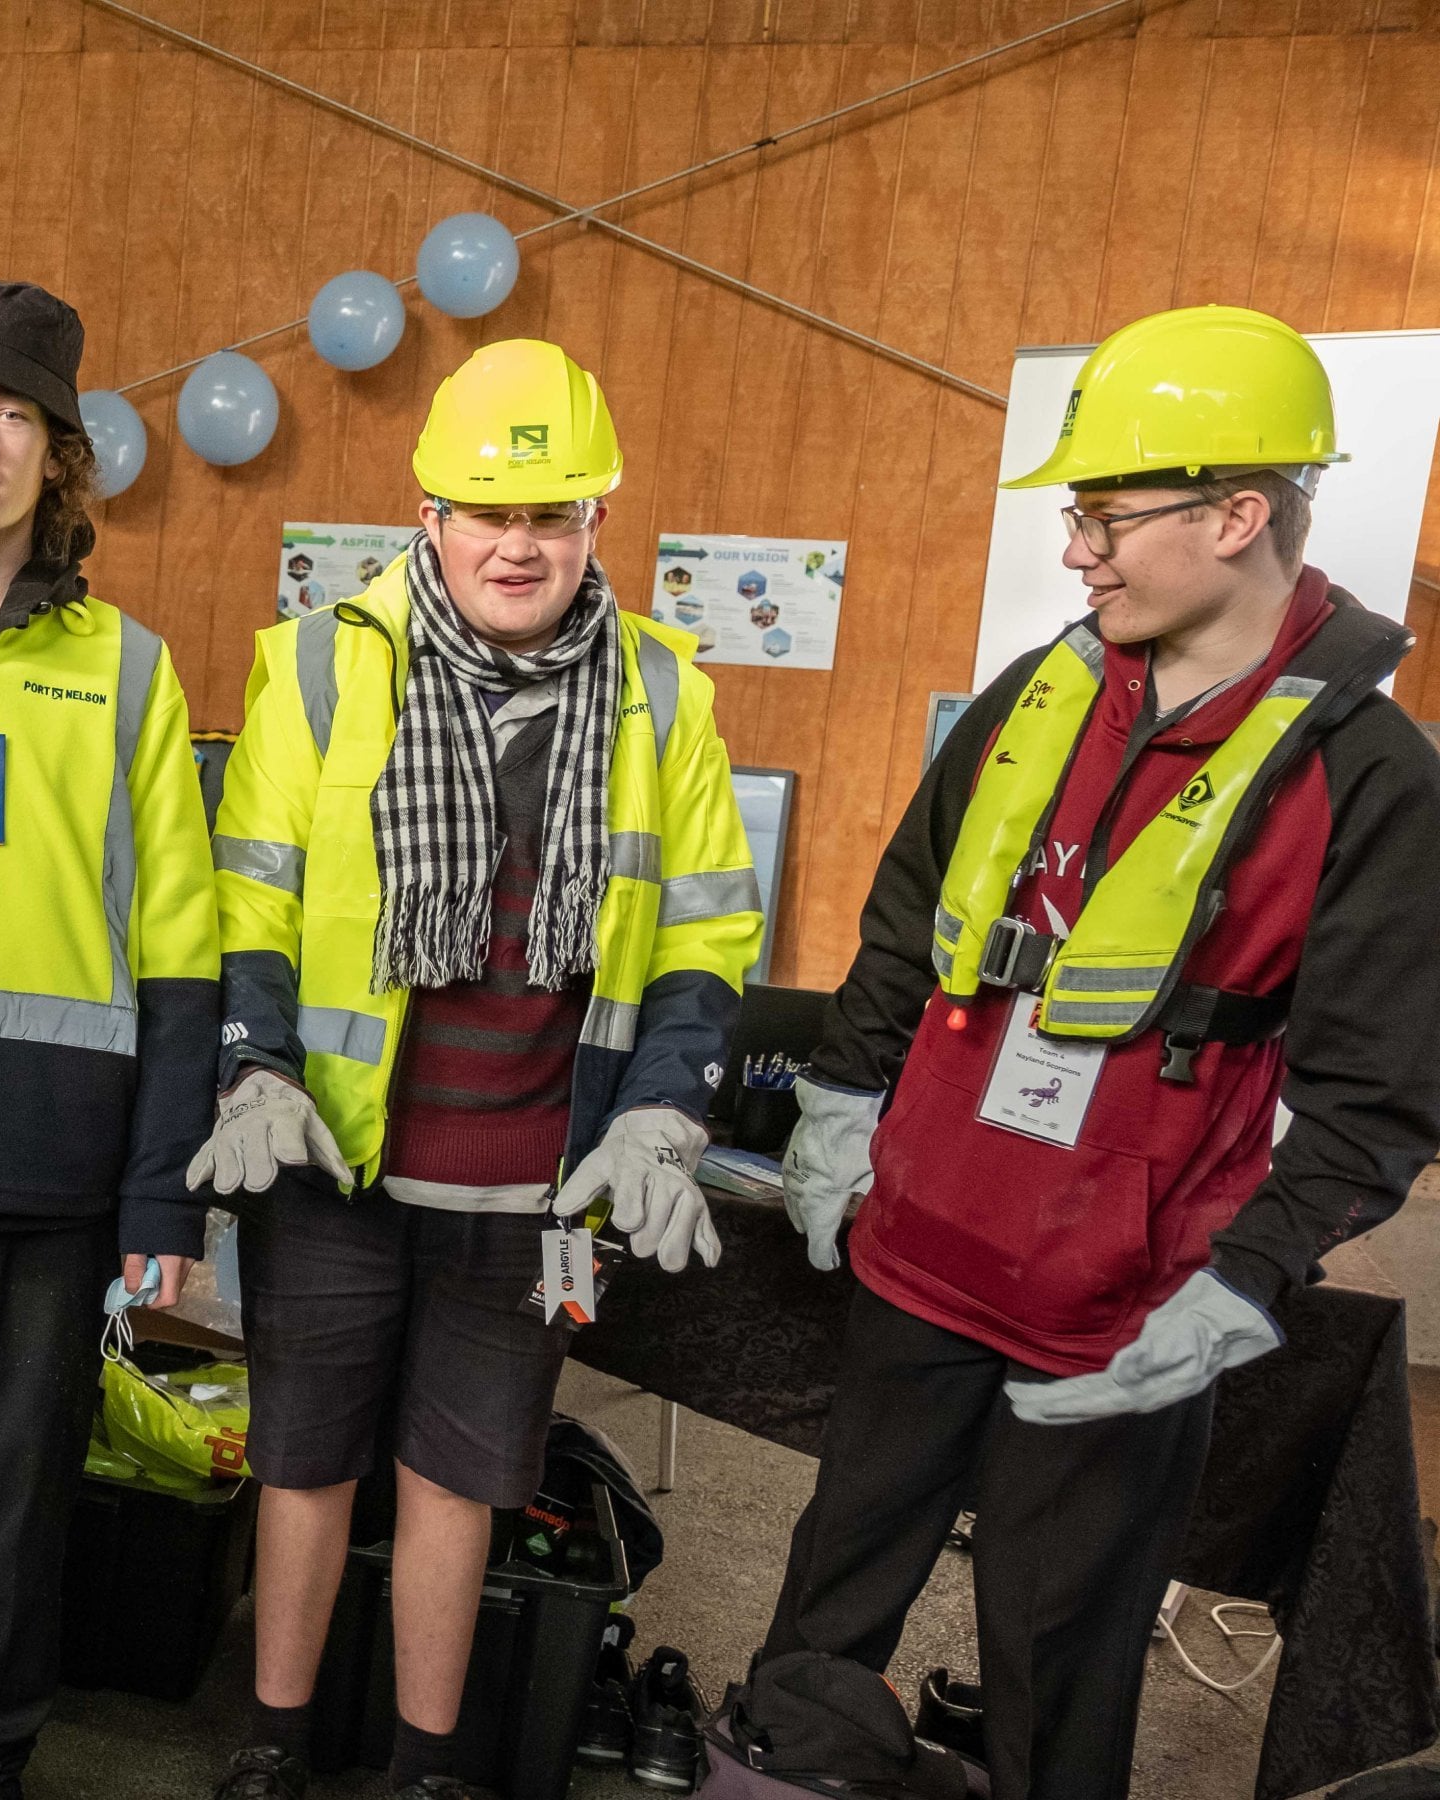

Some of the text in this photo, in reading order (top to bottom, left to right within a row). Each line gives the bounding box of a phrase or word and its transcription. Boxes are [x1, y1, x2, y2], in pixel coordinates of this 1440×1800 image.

[341, 537, 386, 549] ASPIRE
[713, 551, 790, 563] OUR VISION
[23, 680, 107, 706] PORT NELSON
[622, 702, 651, 719] PORT
[1040, 1047, 1059, 1058] Team
[1016, 1052, 1081, 1077] Nayland Scorpions
[560, 1238, 570, 1274] ARGYLE
